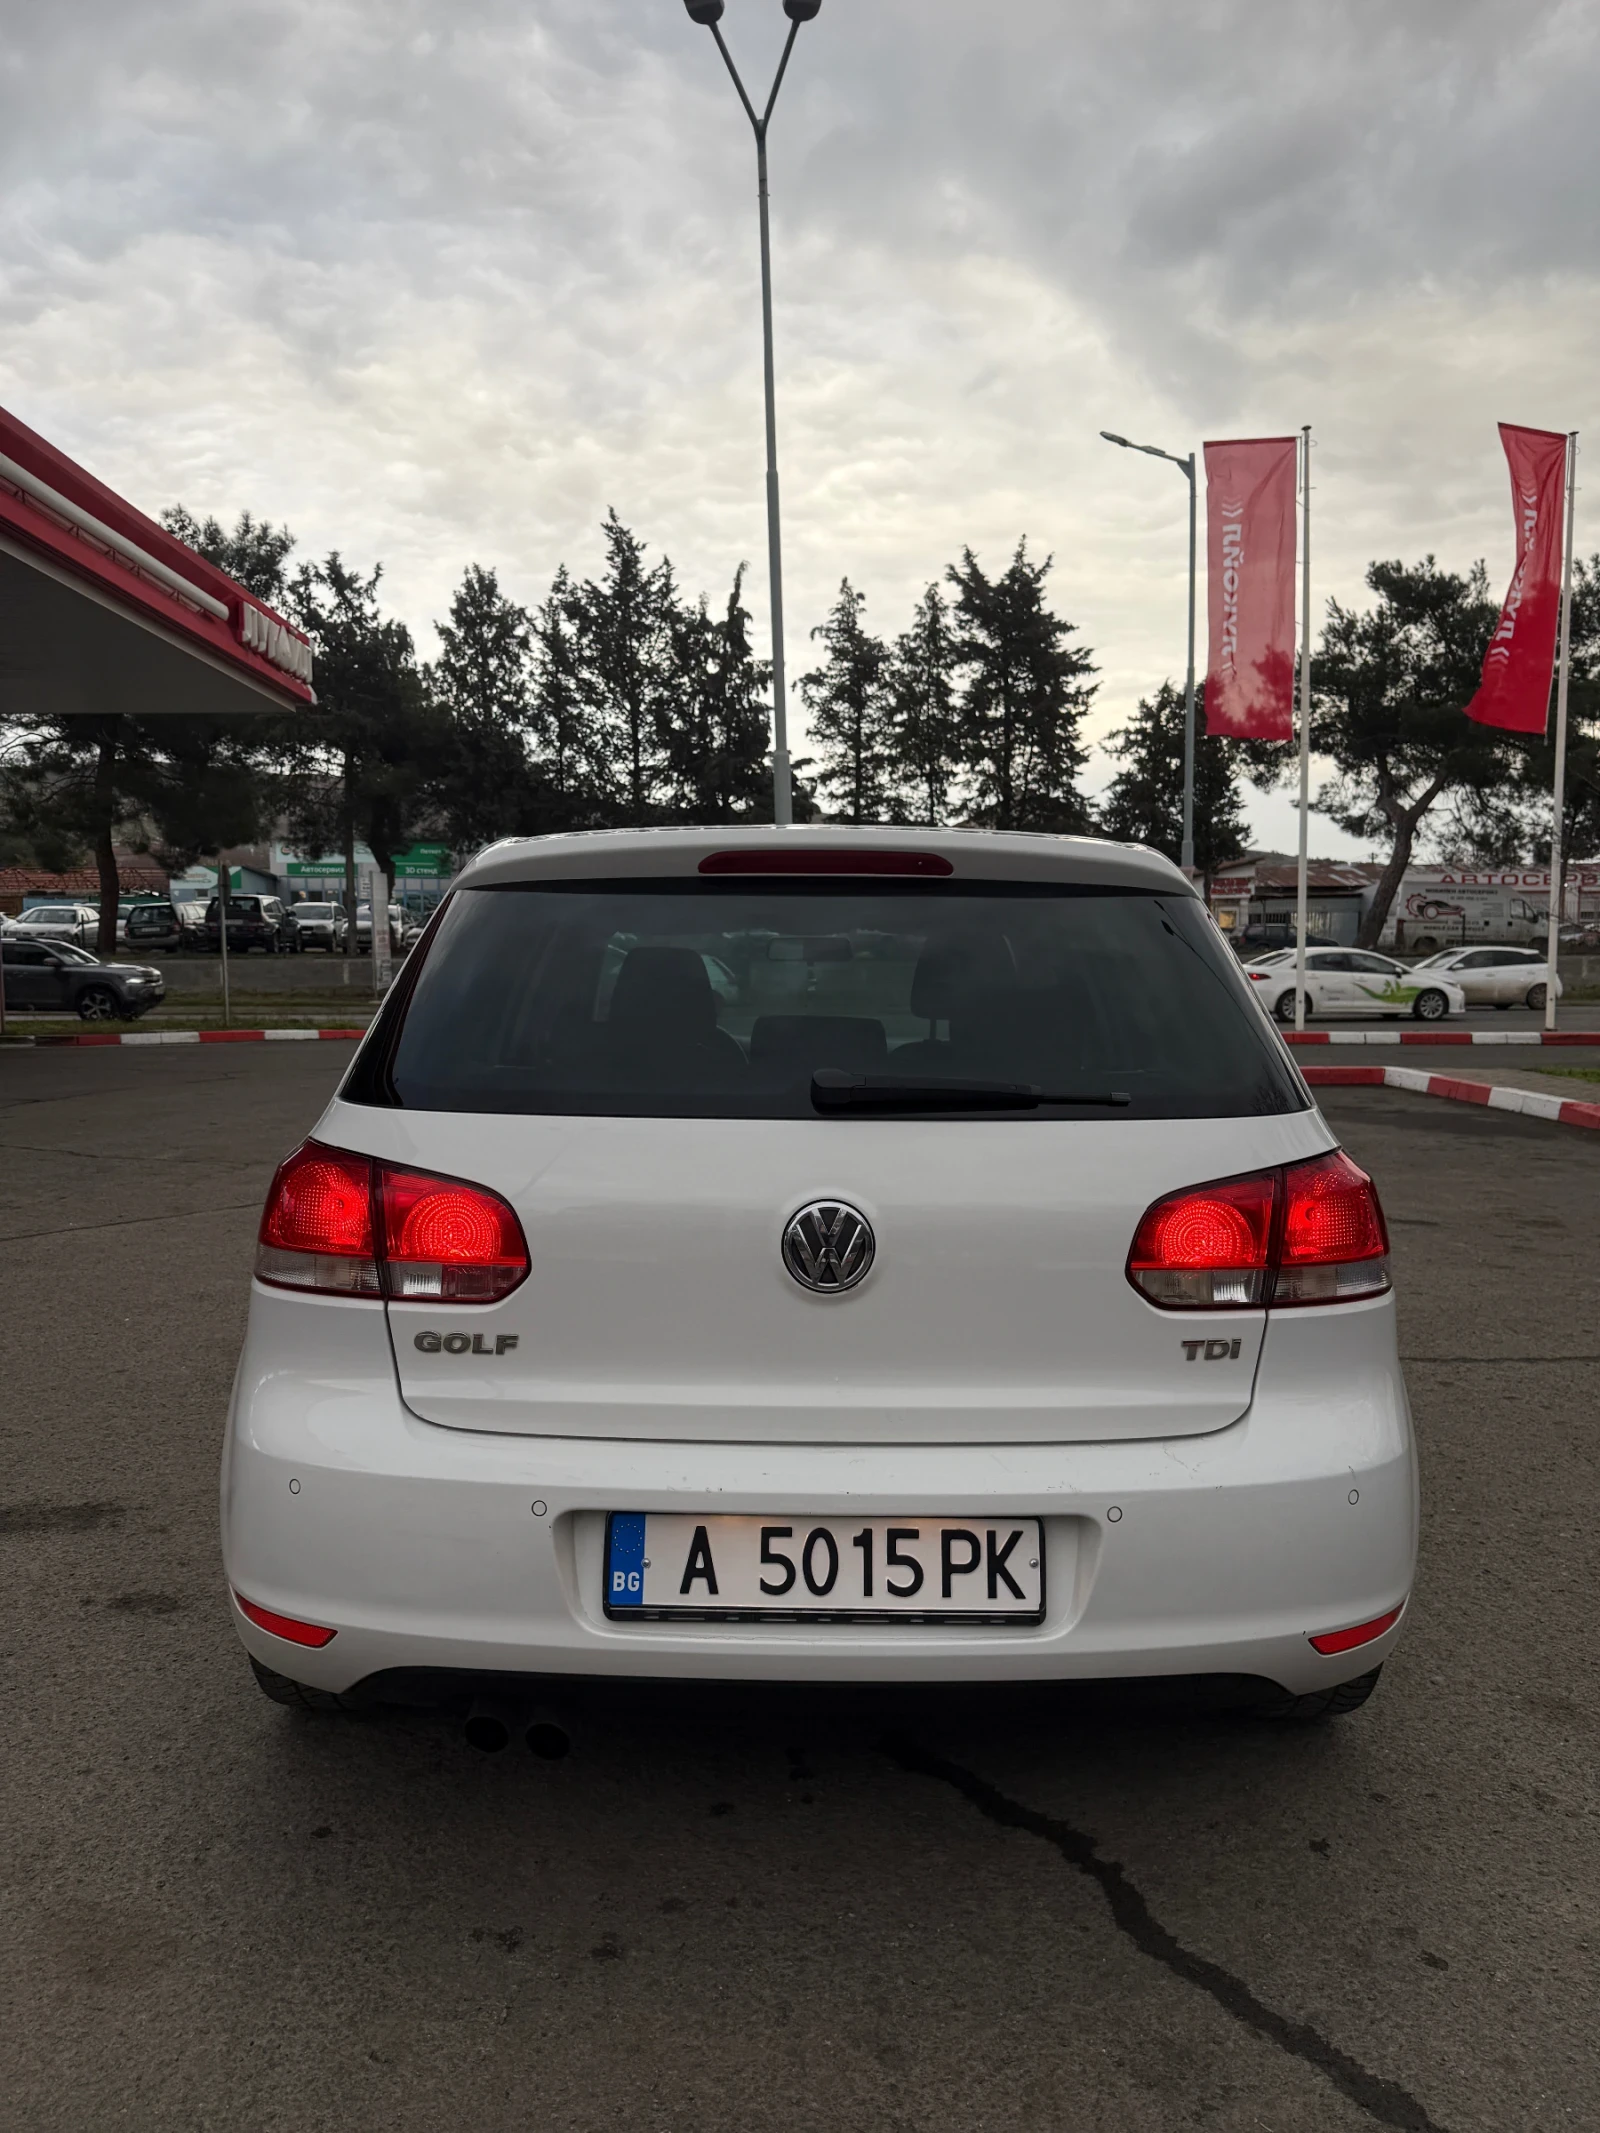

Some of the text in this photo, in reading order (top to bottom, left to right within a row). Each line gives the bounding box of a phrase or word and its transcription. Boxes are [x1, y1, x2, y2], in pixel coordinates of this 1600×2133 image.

[301, 865, 345, 874] Автосервиз
[416, 867, 438, 875] стенд
[413, 1330, 519, 1355] GOLF
[1181, 1338, 1242, 1361] TDI
[679, 1525, 719, 1595] A
[612, 1571, 640, 1592] BG
